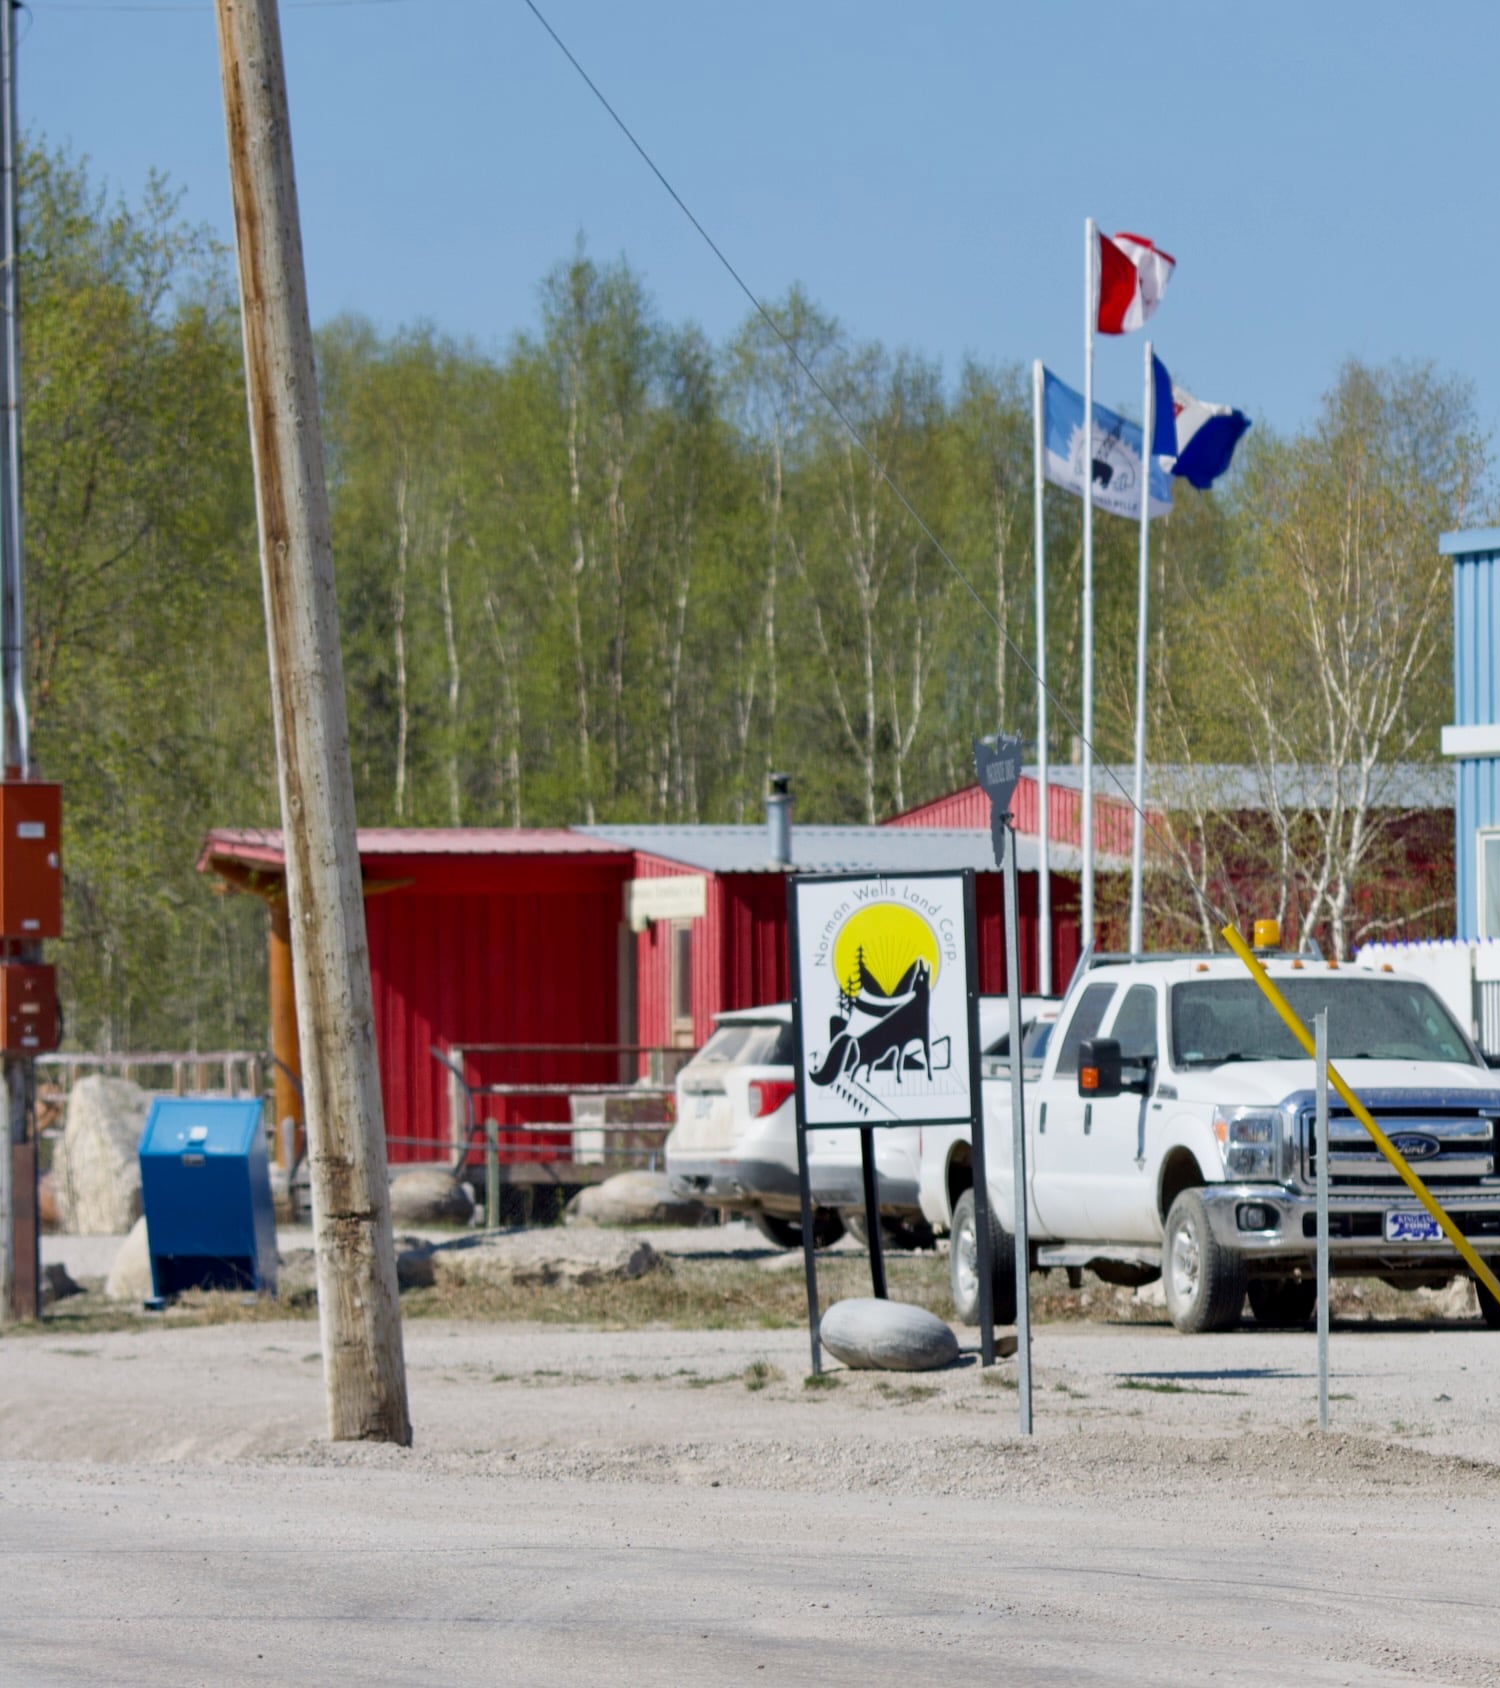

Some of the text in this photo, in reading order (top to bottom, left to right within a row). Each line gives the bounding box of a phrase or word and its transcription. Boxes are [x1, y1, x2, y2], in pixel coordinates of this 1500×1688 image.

[813, 879, 957, 967] Norman Wells Land Corp.
